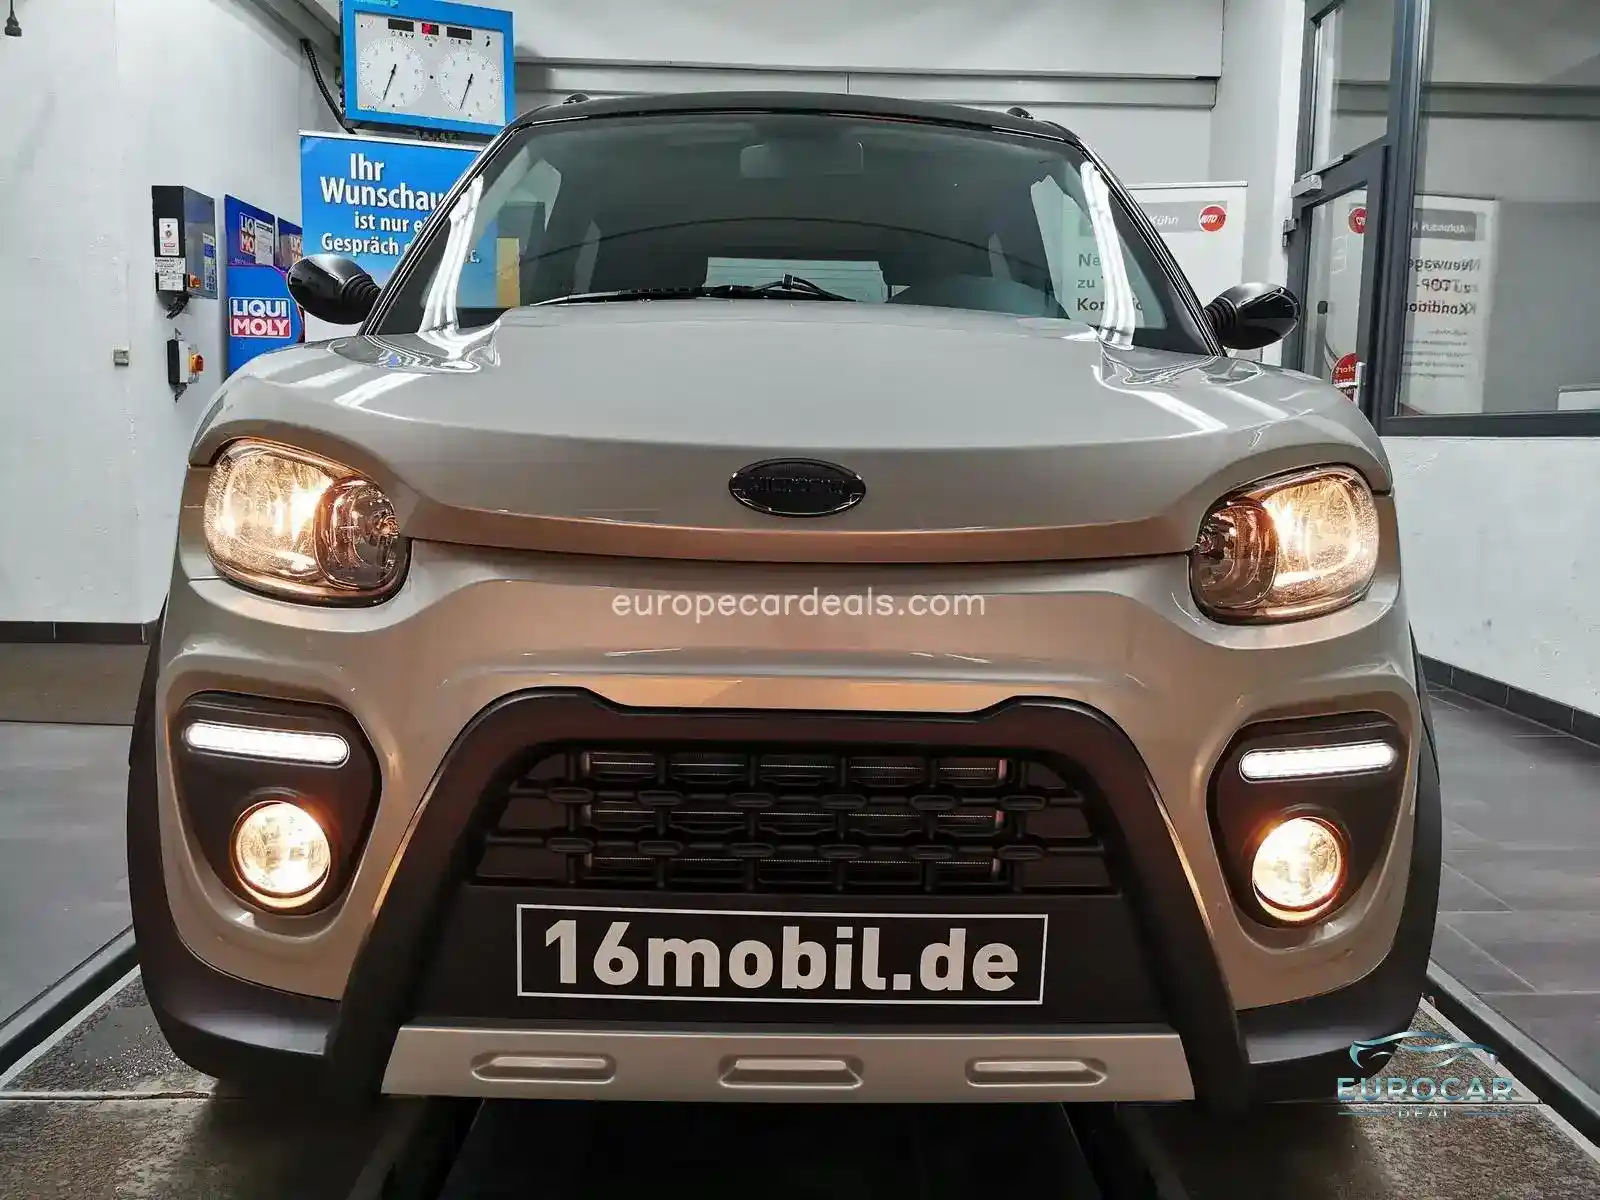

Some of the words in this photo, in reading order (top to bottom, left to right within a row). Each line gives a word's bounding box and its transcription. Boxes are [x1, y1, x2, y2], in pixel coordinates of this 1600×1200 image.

[350, 152, 385, 182] Ihr
[353, 211, 376, 231] ist
[380, 216, 410, 234] nur
[321, 232, 399, 257] Gespräch
[232, 299, 287, 318] LIQUI
[233, 318, 289, 336] MOLY
[544, 919, 1019, 992] 16mobil.de
